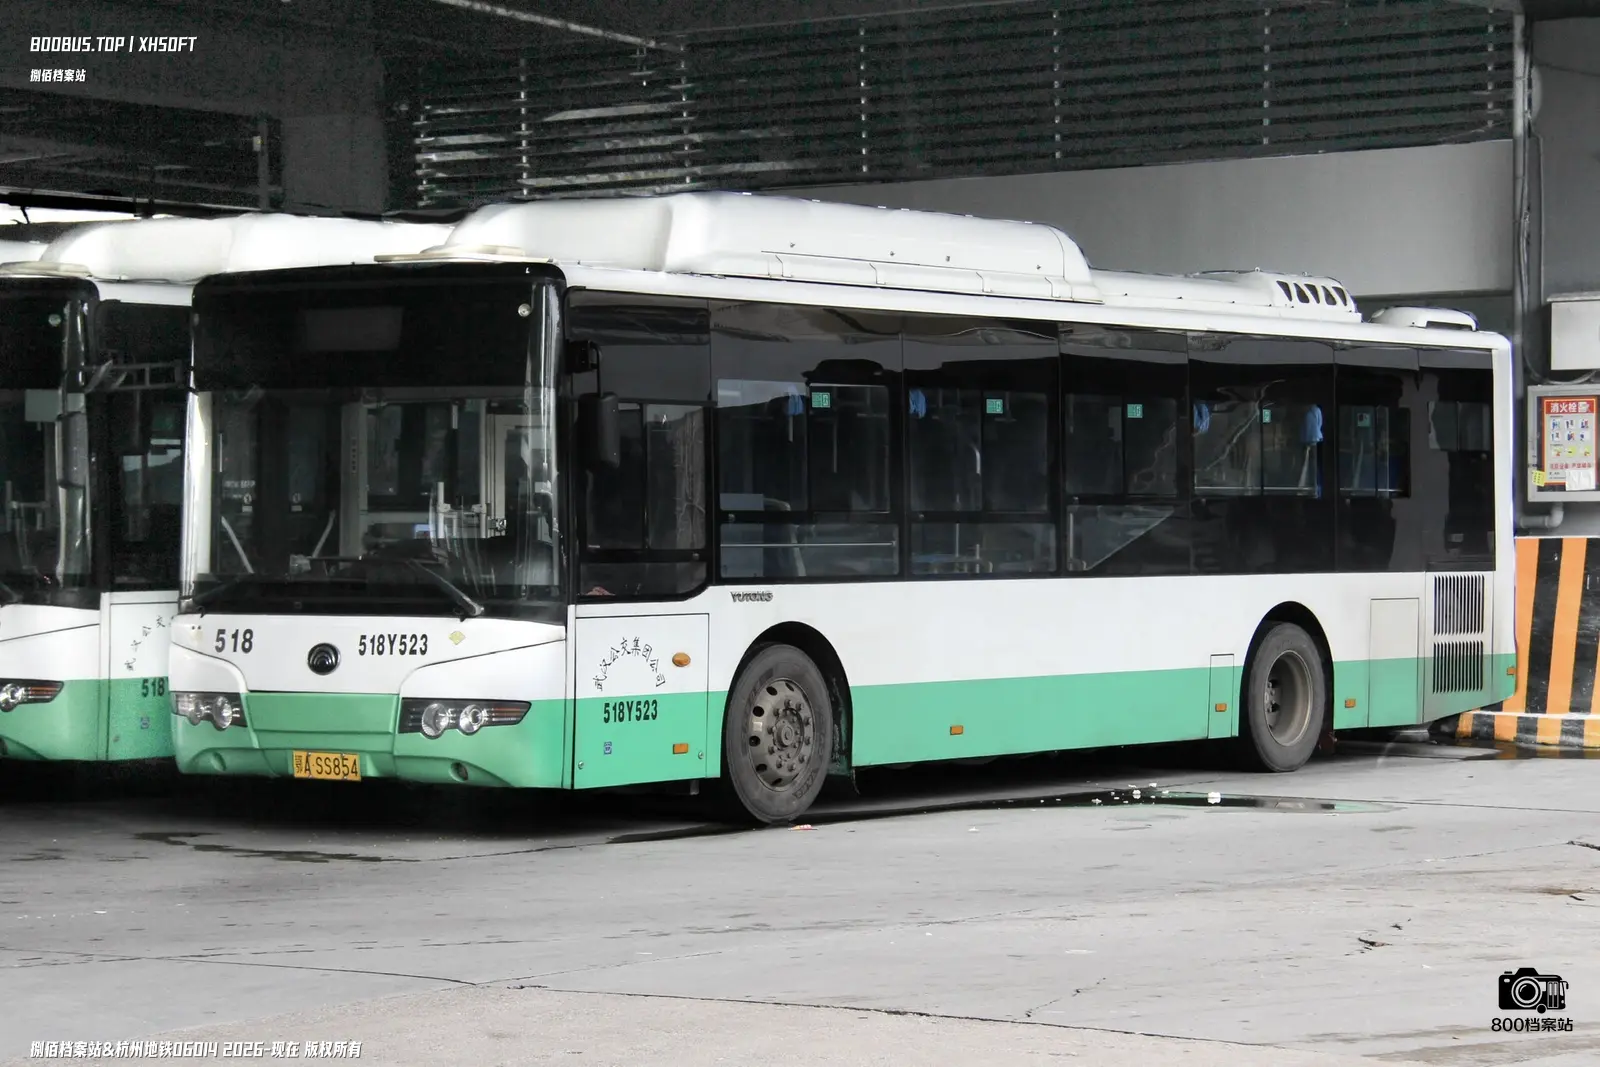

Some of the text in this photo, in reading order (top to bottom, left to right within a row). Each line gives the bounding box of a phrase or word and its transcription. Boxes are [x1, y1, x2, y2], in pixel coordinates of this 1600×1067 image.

[214, 628, 254, 653] 518
[358, 633, 428, 656] 518Y523
[603, 699, 658, 724] 518Y523
